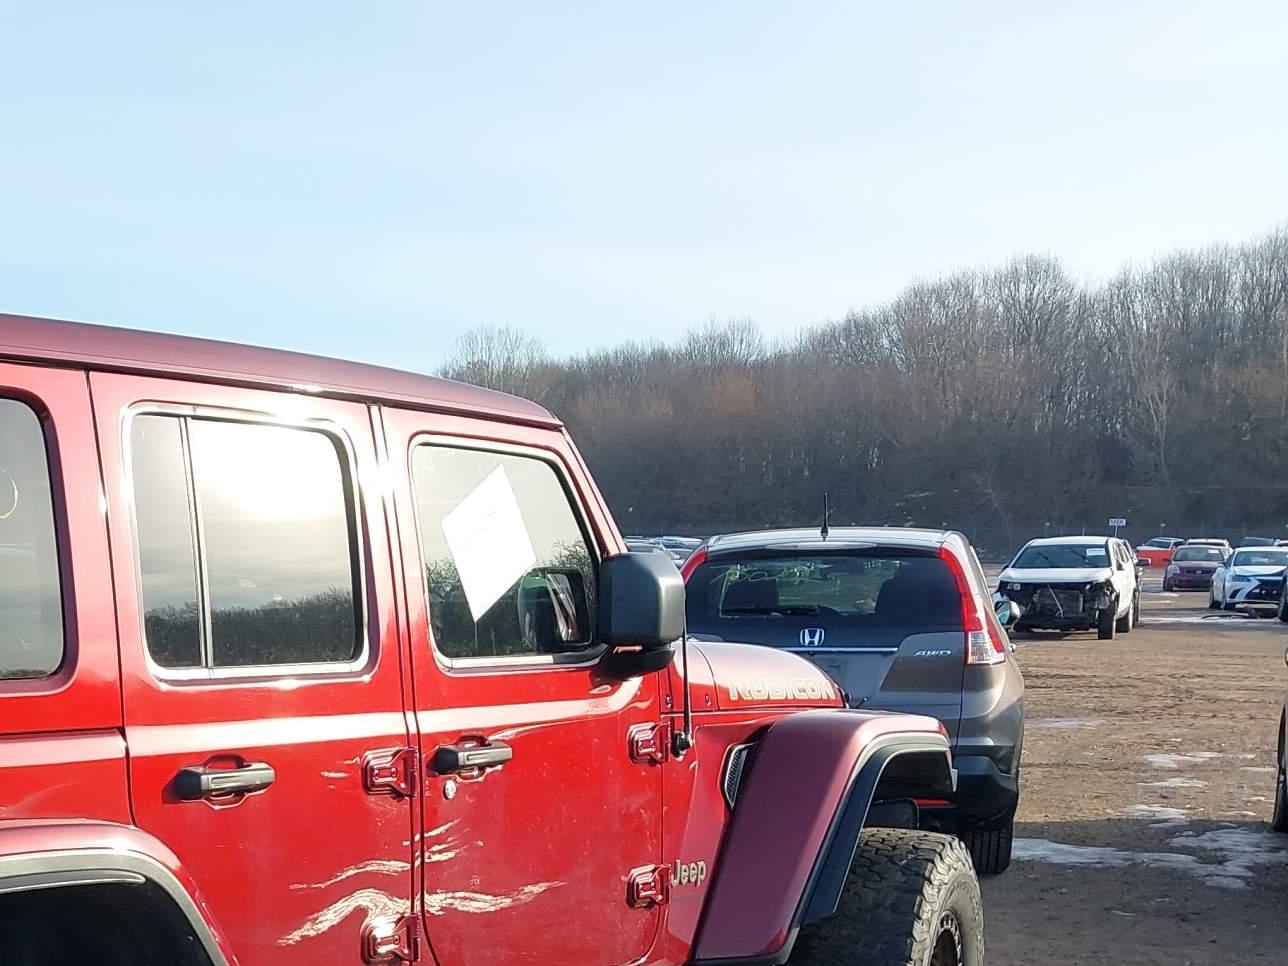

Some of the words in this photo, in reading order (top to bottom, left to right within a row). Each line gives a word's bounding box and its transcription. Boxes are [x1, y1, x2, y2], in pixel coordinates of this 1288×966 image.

[912, 649, 952, 657] AWD
[728, 679, 836, 701] RUBICON
[670, 859, 707, 888] Jeep
